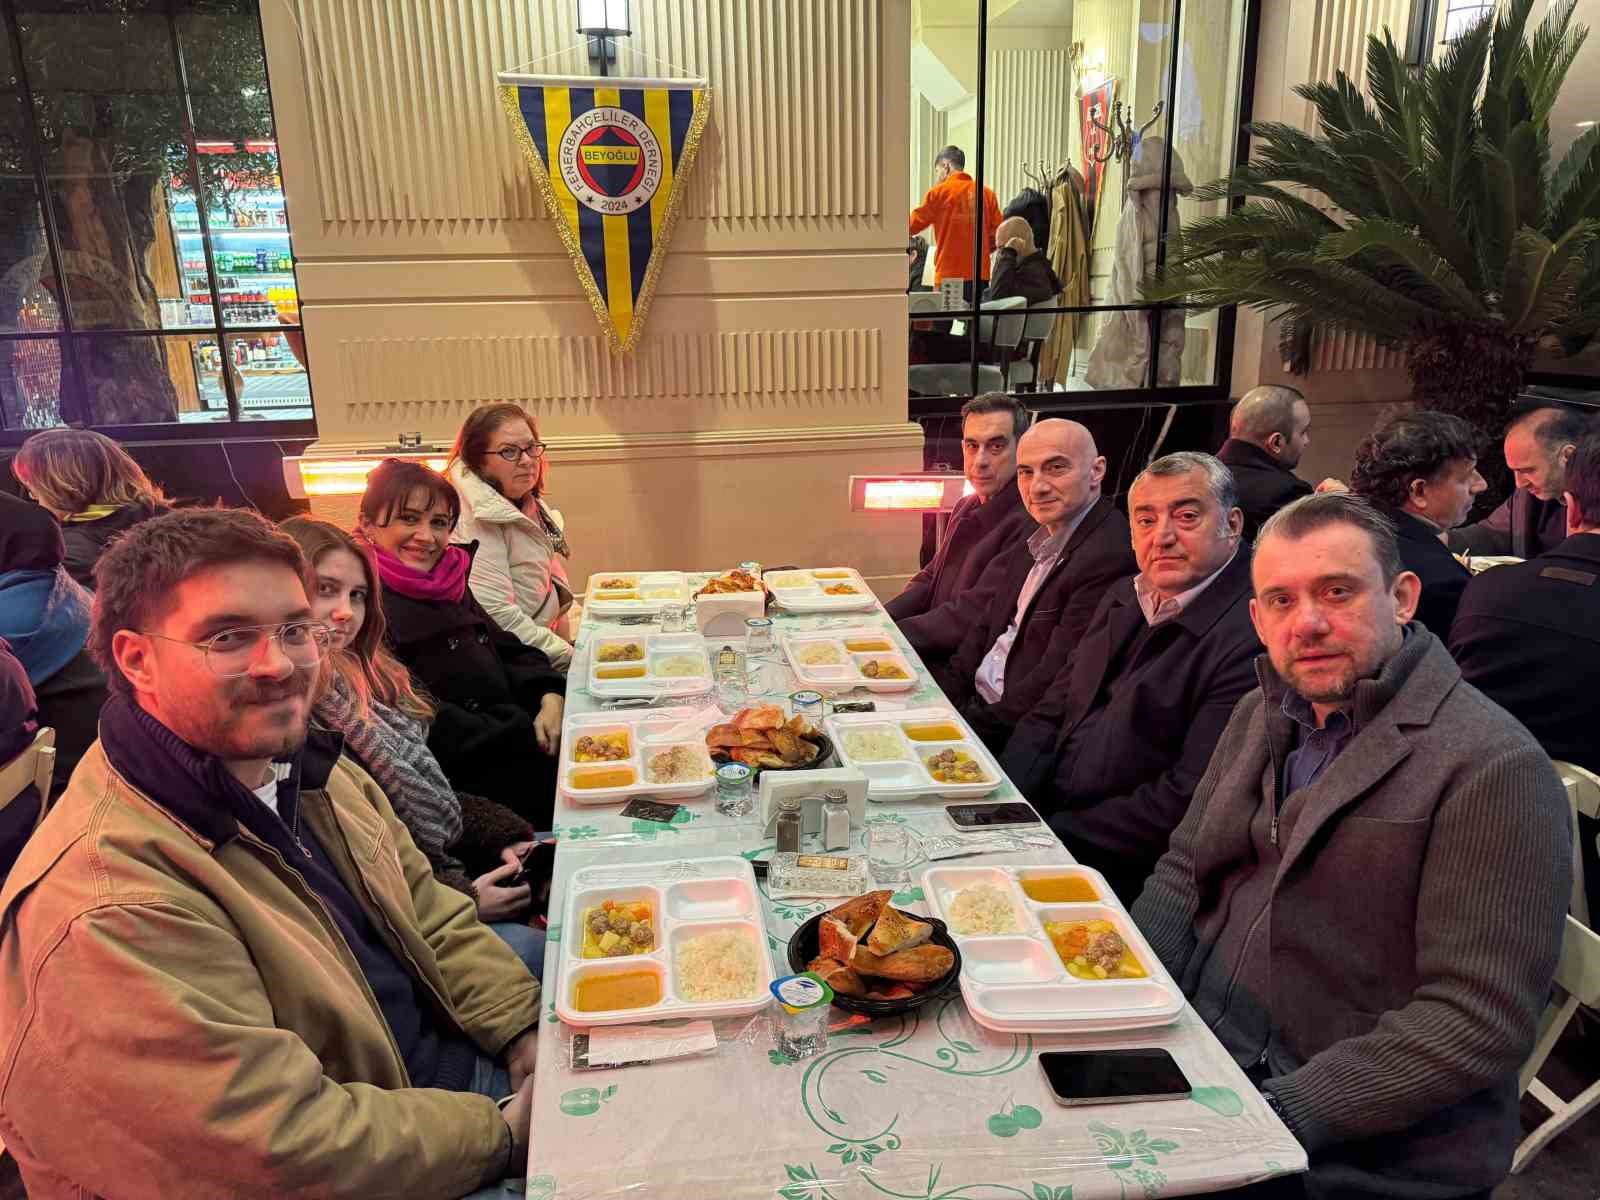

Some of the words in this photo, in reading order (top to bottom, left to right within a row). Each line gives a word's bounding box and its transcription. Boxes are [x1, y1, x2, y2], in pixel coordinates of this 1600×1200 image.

[563, 110, 638, 192] FENERBAHÇELİLER
[584, 150, 638, 161] BEYOĞLU
[601, 200, 628, 211] 2024
